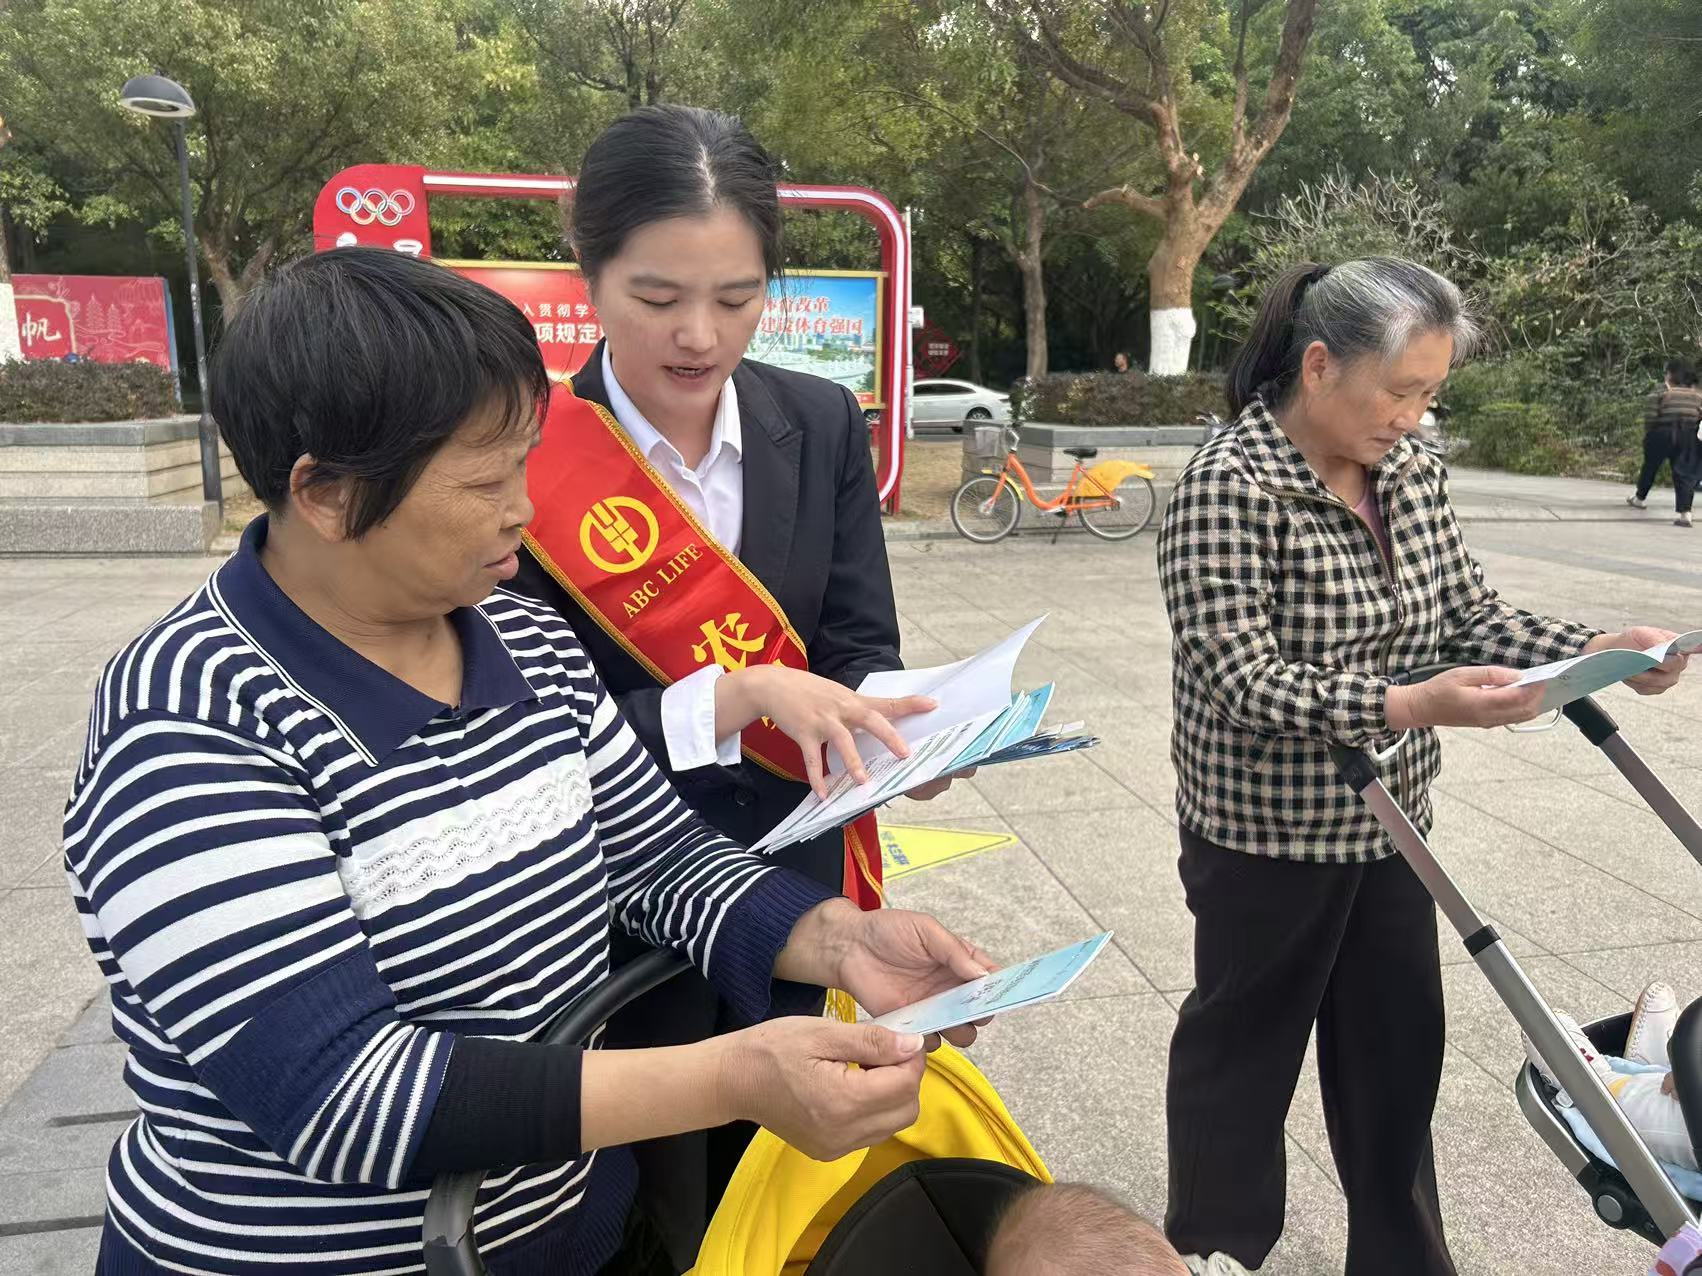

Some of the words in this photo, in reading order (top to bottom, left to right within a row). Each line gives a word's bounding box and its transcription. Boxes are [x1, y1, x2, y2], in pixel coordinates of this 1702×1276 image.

[522, 303, 599, 318] 入贯彻学
[21, 311, 62, 347] 帆
[534, 322, 606, 344] 项规定
[760, 317, 863, 336] 建设体育强国
[621, 580, 660, 620] ABC
[656, 542, 704, 585] LIFE
